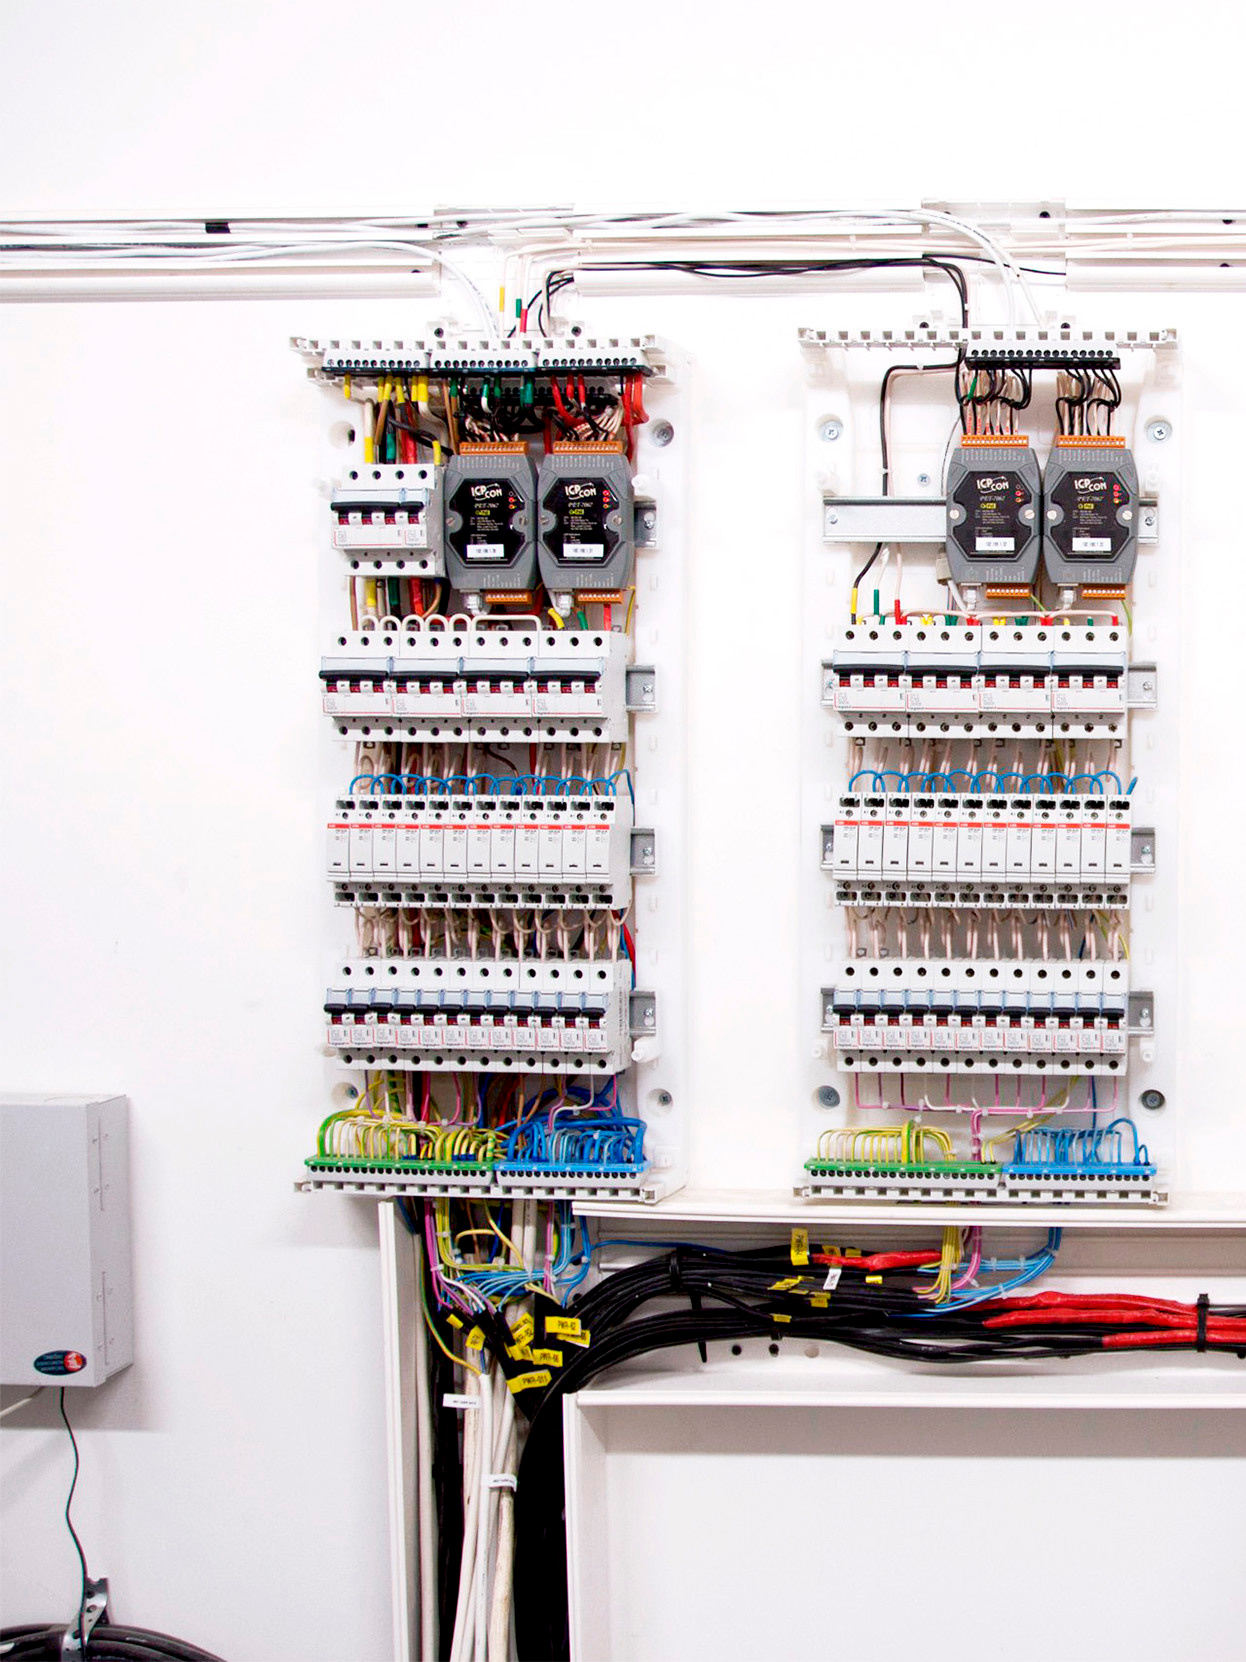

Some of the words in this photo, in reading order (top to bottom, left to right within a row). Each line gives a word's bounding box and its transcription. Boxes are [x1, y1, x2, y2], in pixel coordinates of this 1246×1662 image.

[976, 478, 993, 490] ICP
[991, 481, 1009, 491] CON
[1074, 478, 1091, 489] ICP
[1088, 481, 1107, 491] CON
[471, 485, 487, 497] ICP
[484, 489, 503, 498] CON
[565, 485, 580, 496] ICP
[578, 488, 597, 498] CON
